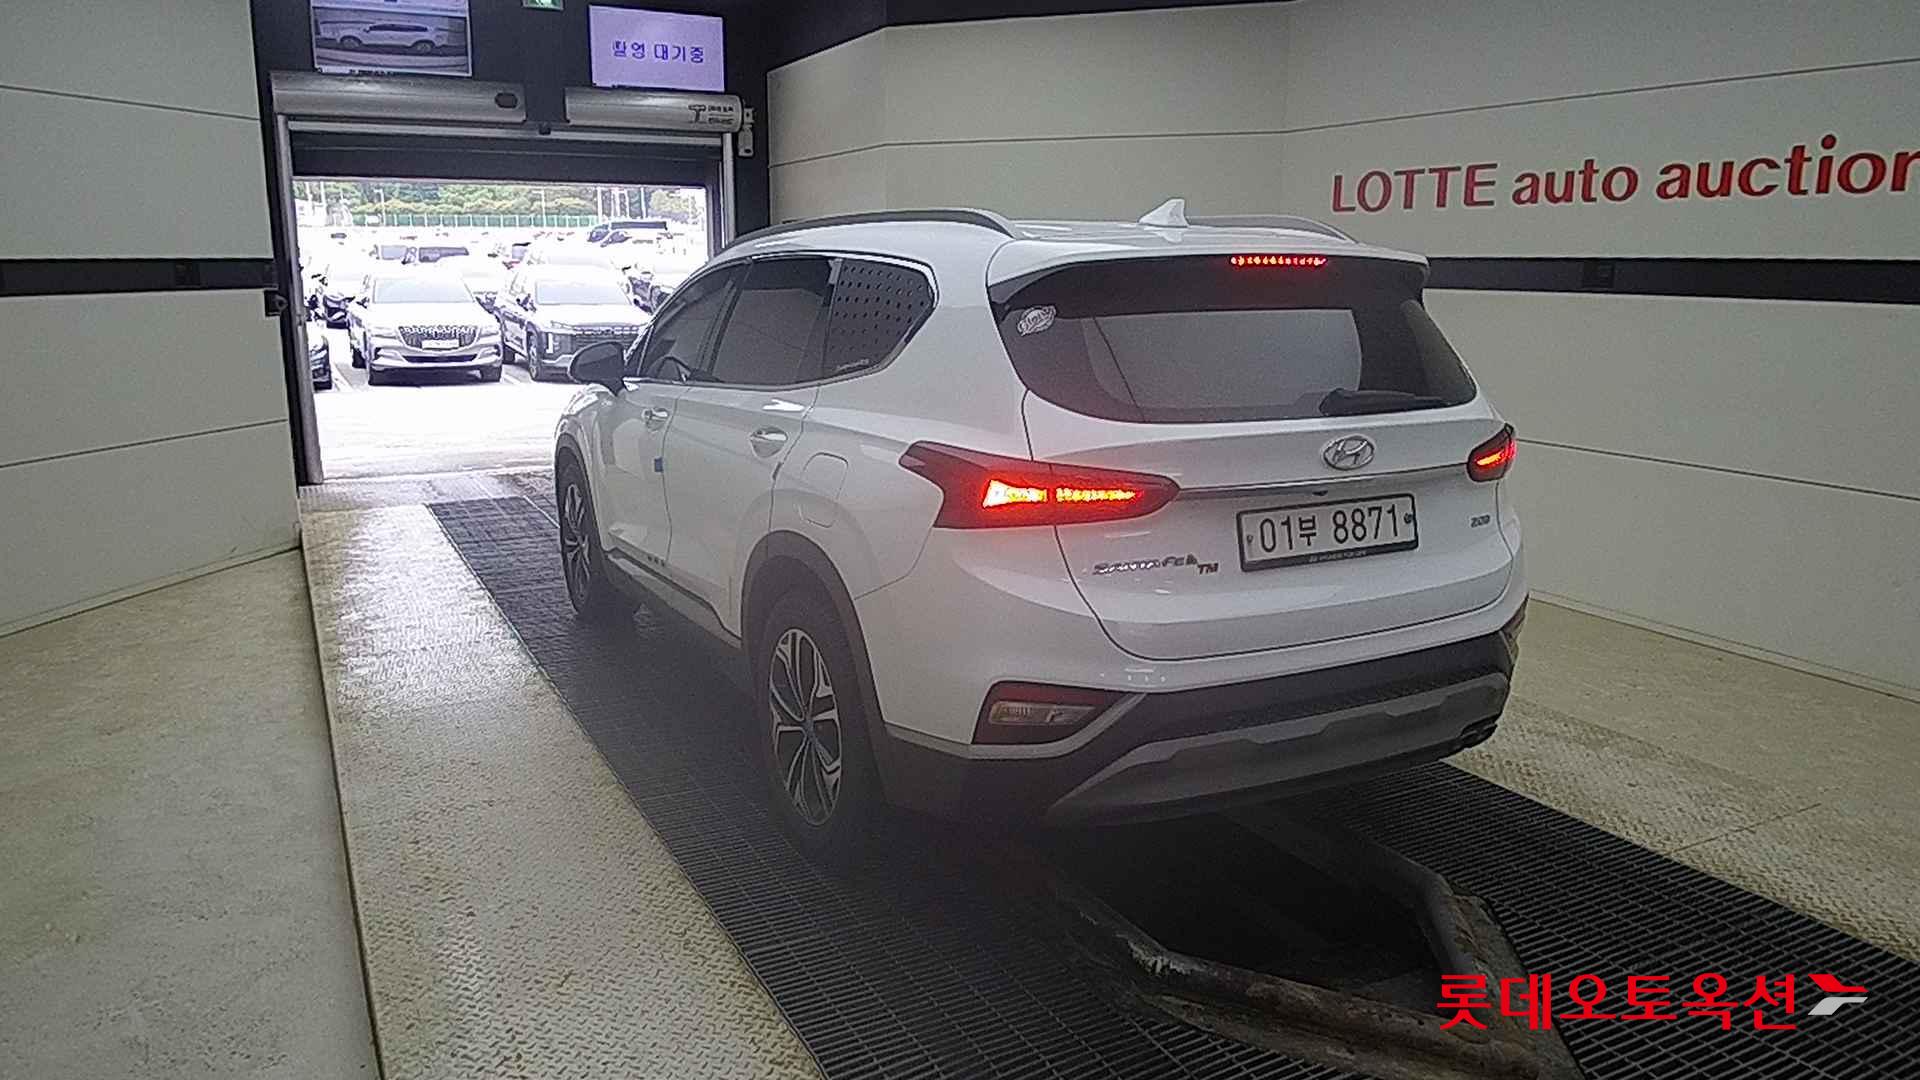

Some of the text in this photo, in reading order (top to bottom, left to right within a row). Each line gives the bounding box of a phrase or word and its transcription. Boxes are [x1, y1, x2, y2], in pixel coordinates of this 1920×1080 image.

[654, 43, 704, 64] 대기중
[1332, 163, 1498, 213] LOTTE
[1511, 158, 1639, 205] auto
[1259, 503, 1398, 553] 01부 8871
